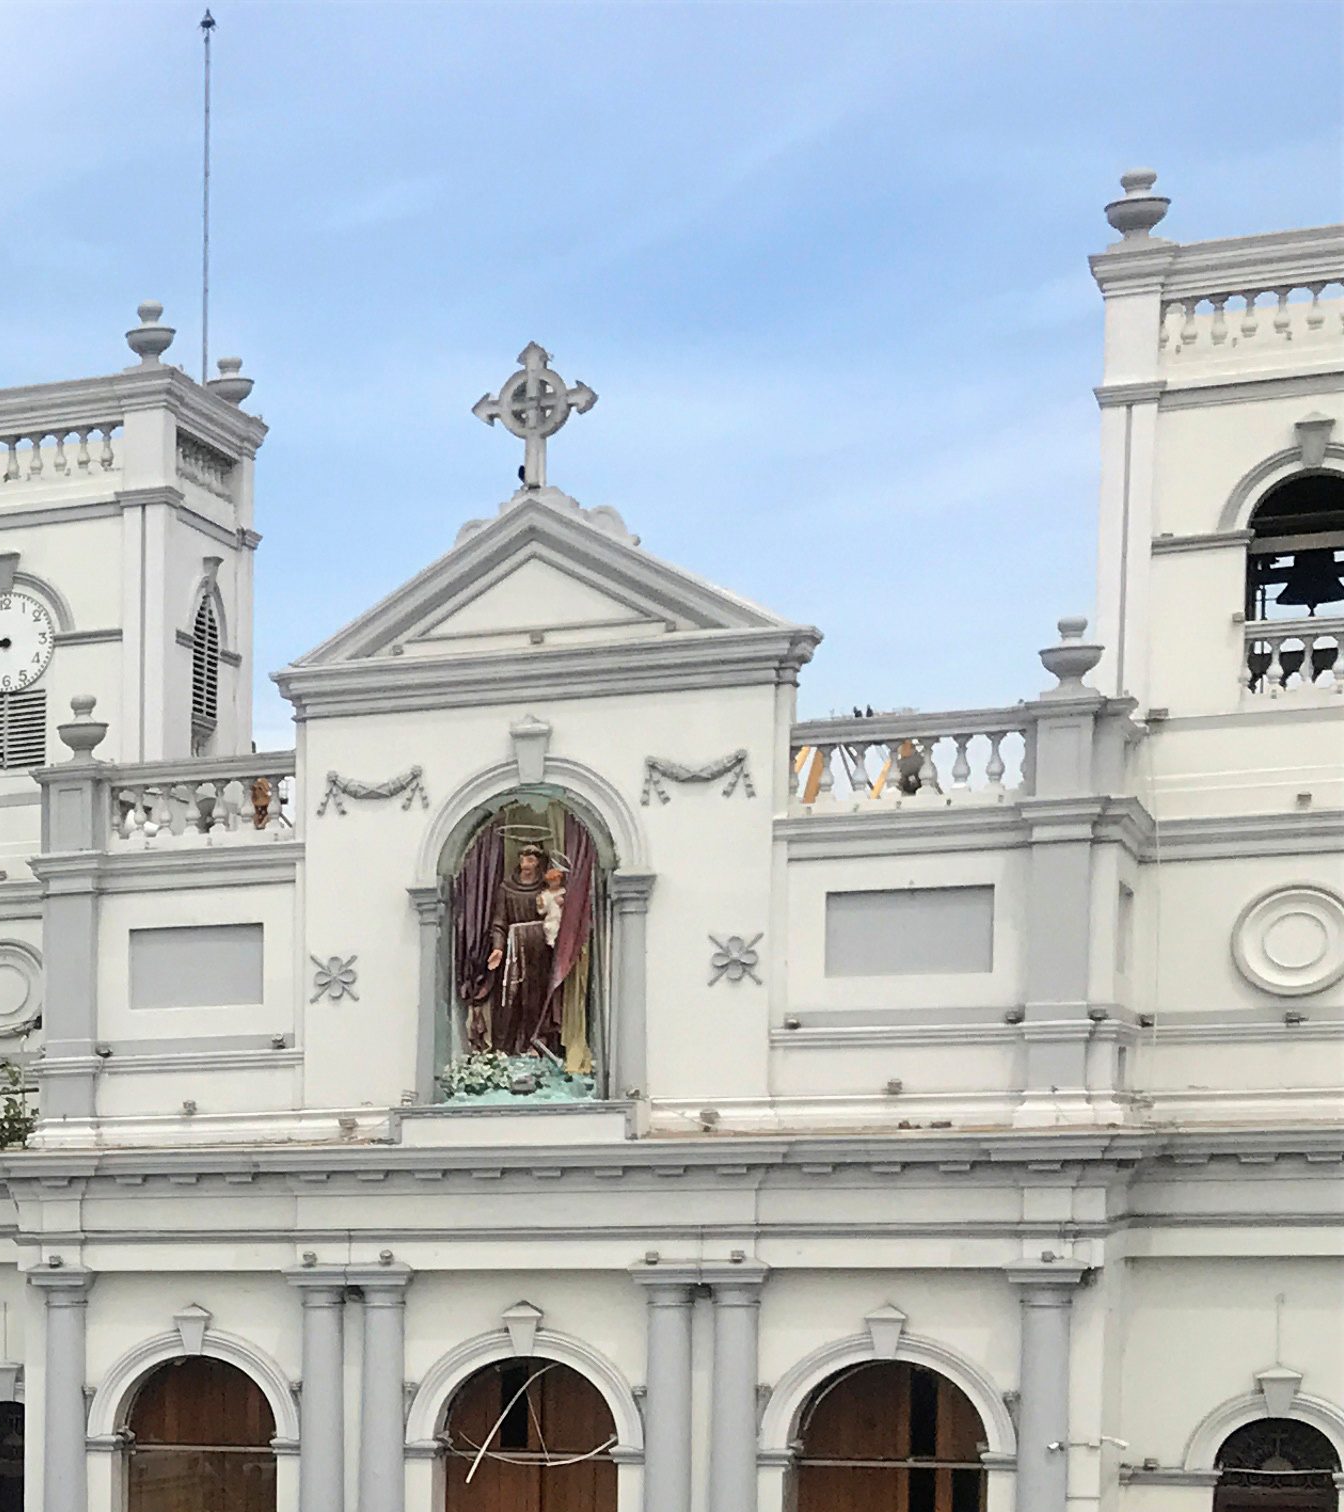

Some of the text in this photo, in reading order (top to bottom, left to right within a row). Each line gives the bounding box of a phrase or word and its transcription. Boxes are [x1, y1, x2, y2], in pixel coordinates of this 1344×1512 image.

[0, 598, 12, 611] 12
[32, 609, 42, 622] 2
[38, 632, 48, 645] 3
[31, 652, 41, 664] 4
[2, 675, 11, 688] 6
[18, 670, 28, 682] 5
